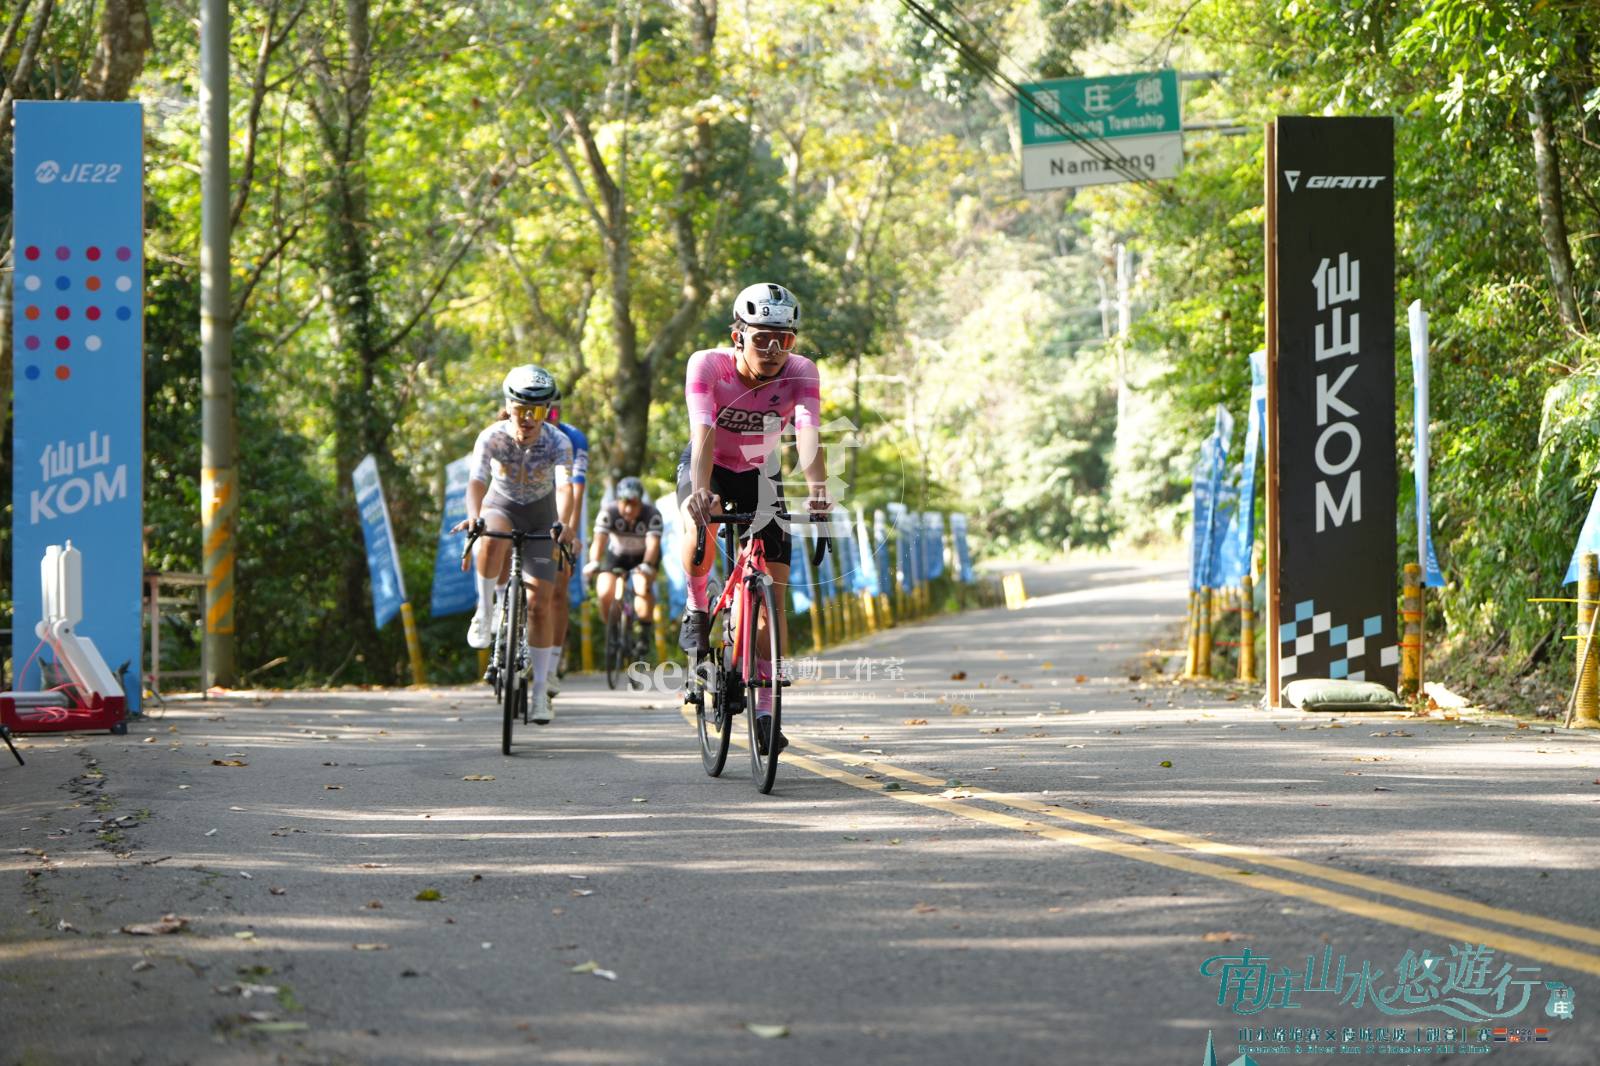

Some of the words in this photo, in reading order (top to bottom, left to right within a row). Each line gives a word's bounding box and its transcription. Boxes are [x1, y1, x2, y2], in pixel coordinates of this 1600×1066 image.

[1107, 112, 1165, 131] Township
[61, 163, 122, 183] JE22
[1305, 175, 1386, 189] GIANT
[40, 430, 110, 482] 仙山
[30, 464, 127, 525] KOM
